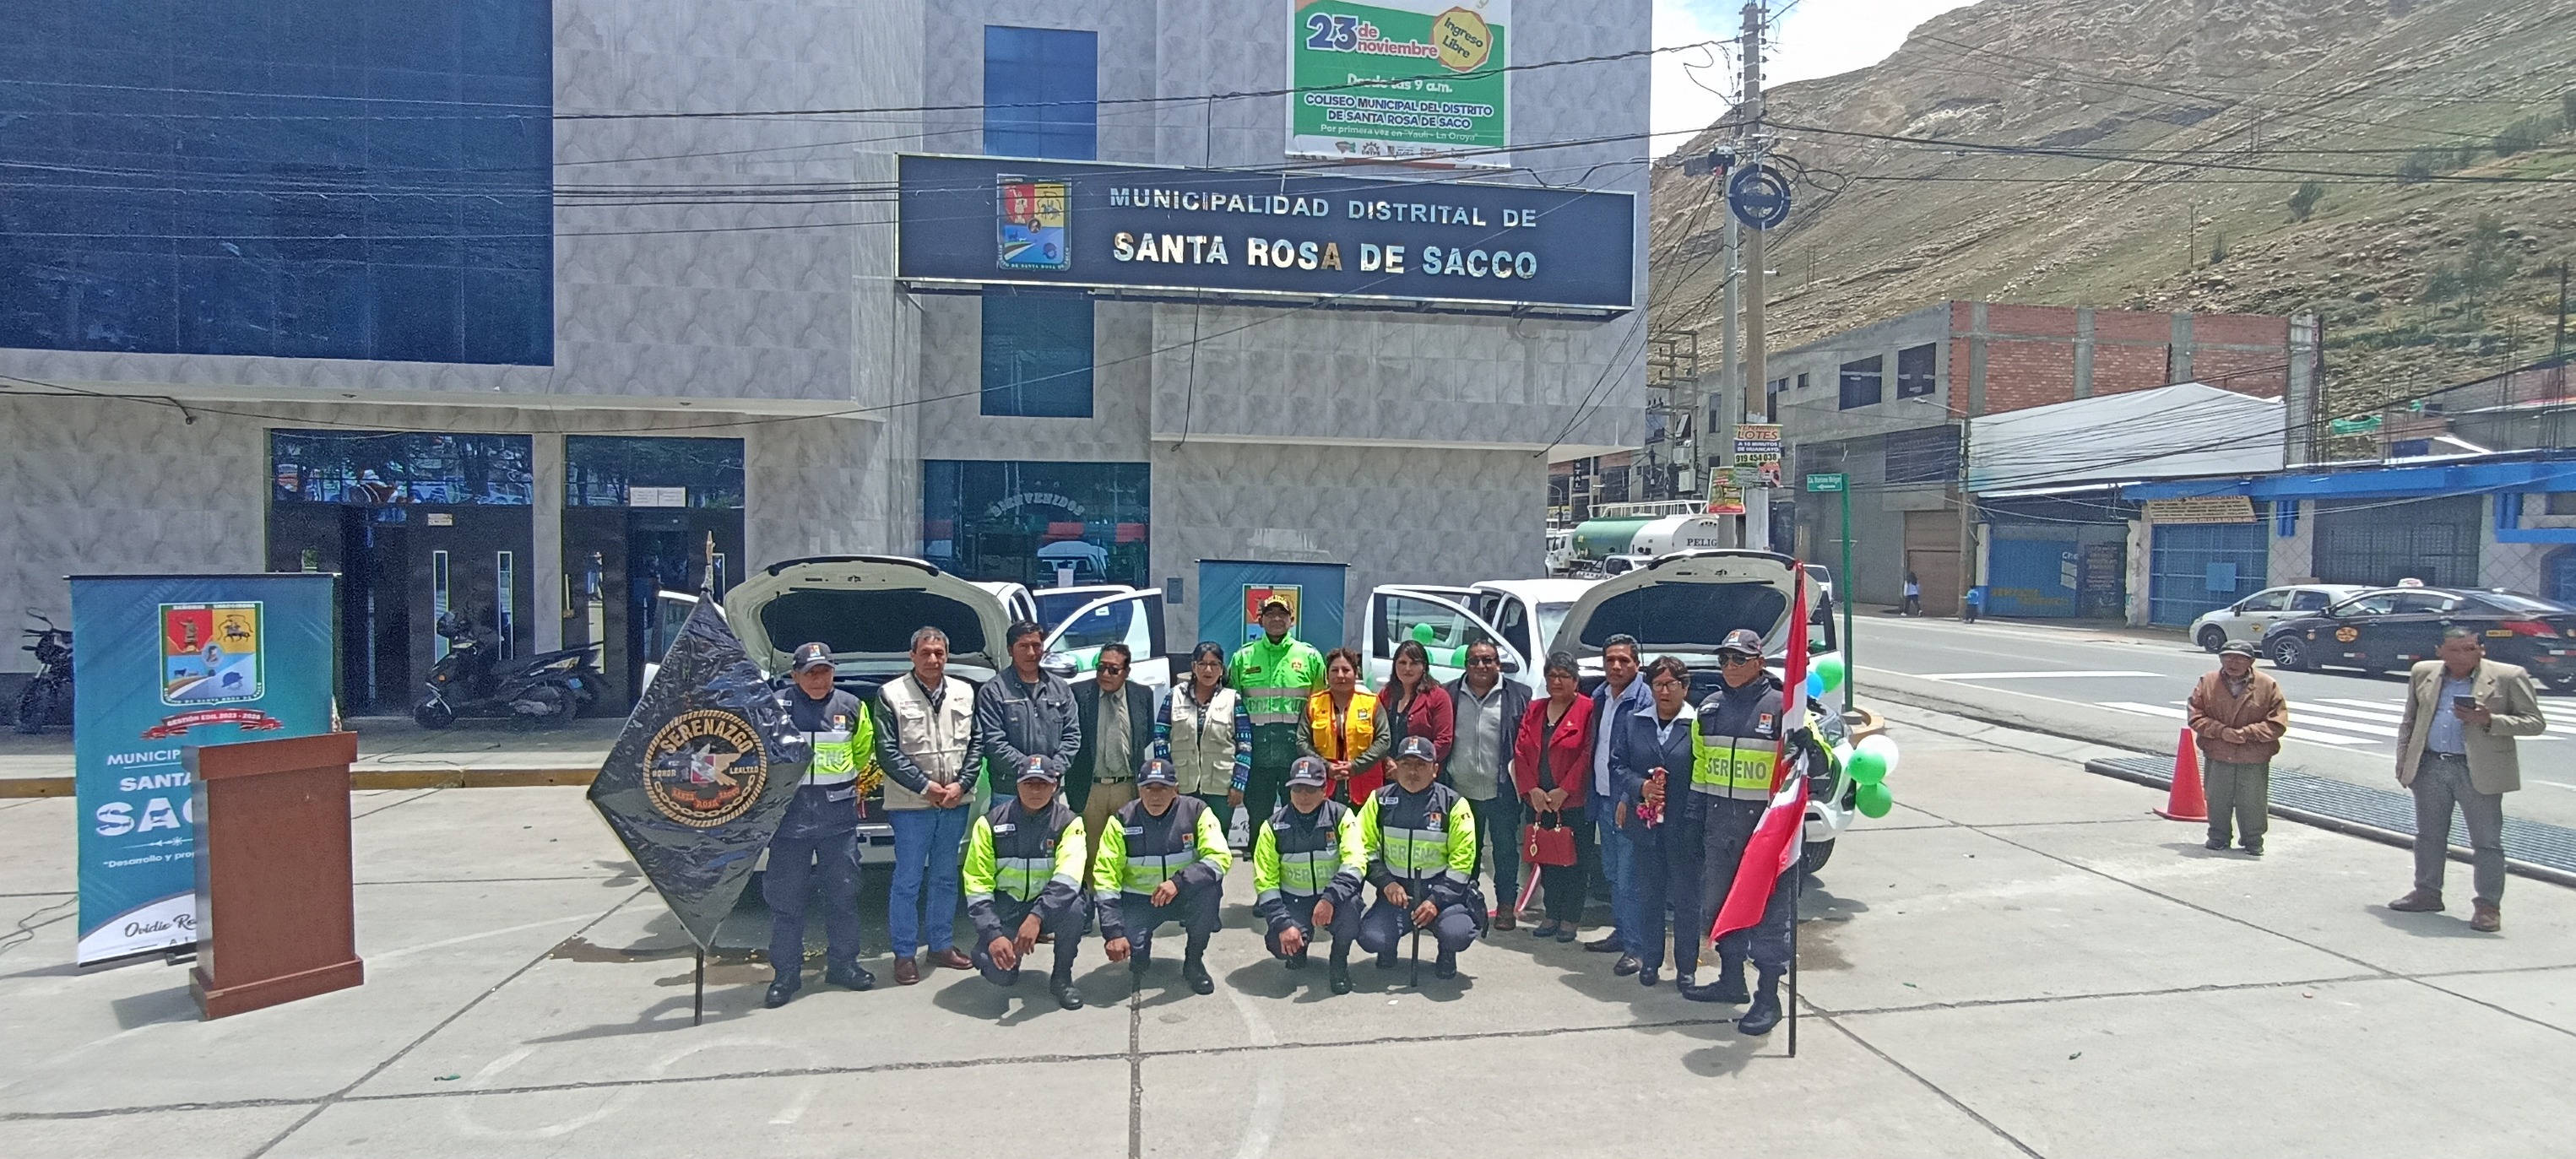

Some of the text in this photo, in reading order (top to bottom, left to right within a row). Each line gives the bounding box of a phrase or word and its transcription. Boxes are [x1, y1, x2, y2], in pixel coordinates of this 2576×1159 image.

[1307, 14, 1358, 51] 23
[1358, 23, 1378, 38] de
[1444, 17, 1483, 48] Ingreso
[1357, 38, 1438, 57] noviembre
[1442, 35, 1470, 58] Libre
[1414, 79, 1423, 90] 9
[1425, 82, 1453, 93] a.m.
[1305, 94, 1493, 116] COLISEO MUNICIPAL DEL DISTRITO
[1328, 110, 1471, 128] DE SANTA ROSA DE SACO
[1338, 126, 1373, 134] primera
[1374, 127, 1390, 136] vez
[1110, 187, 1537, 228] MUNICIPALIDAD DISTRITAL DE
[1113, 232, 1537, 279] SANTA ROSA DE SACCO
[1737, 431, 1778, 440] LOTES
[990, 492, 1085, 517] BIENVENIDOS
[660, 718, 754, 755] SERENAZGO
[652, 769, 676, 777] HONOR
[729, 766, 759, 775] LEALTAD
[1706, 757, 1767, 781] SERENO
[95, 797, 193, 836] SA
